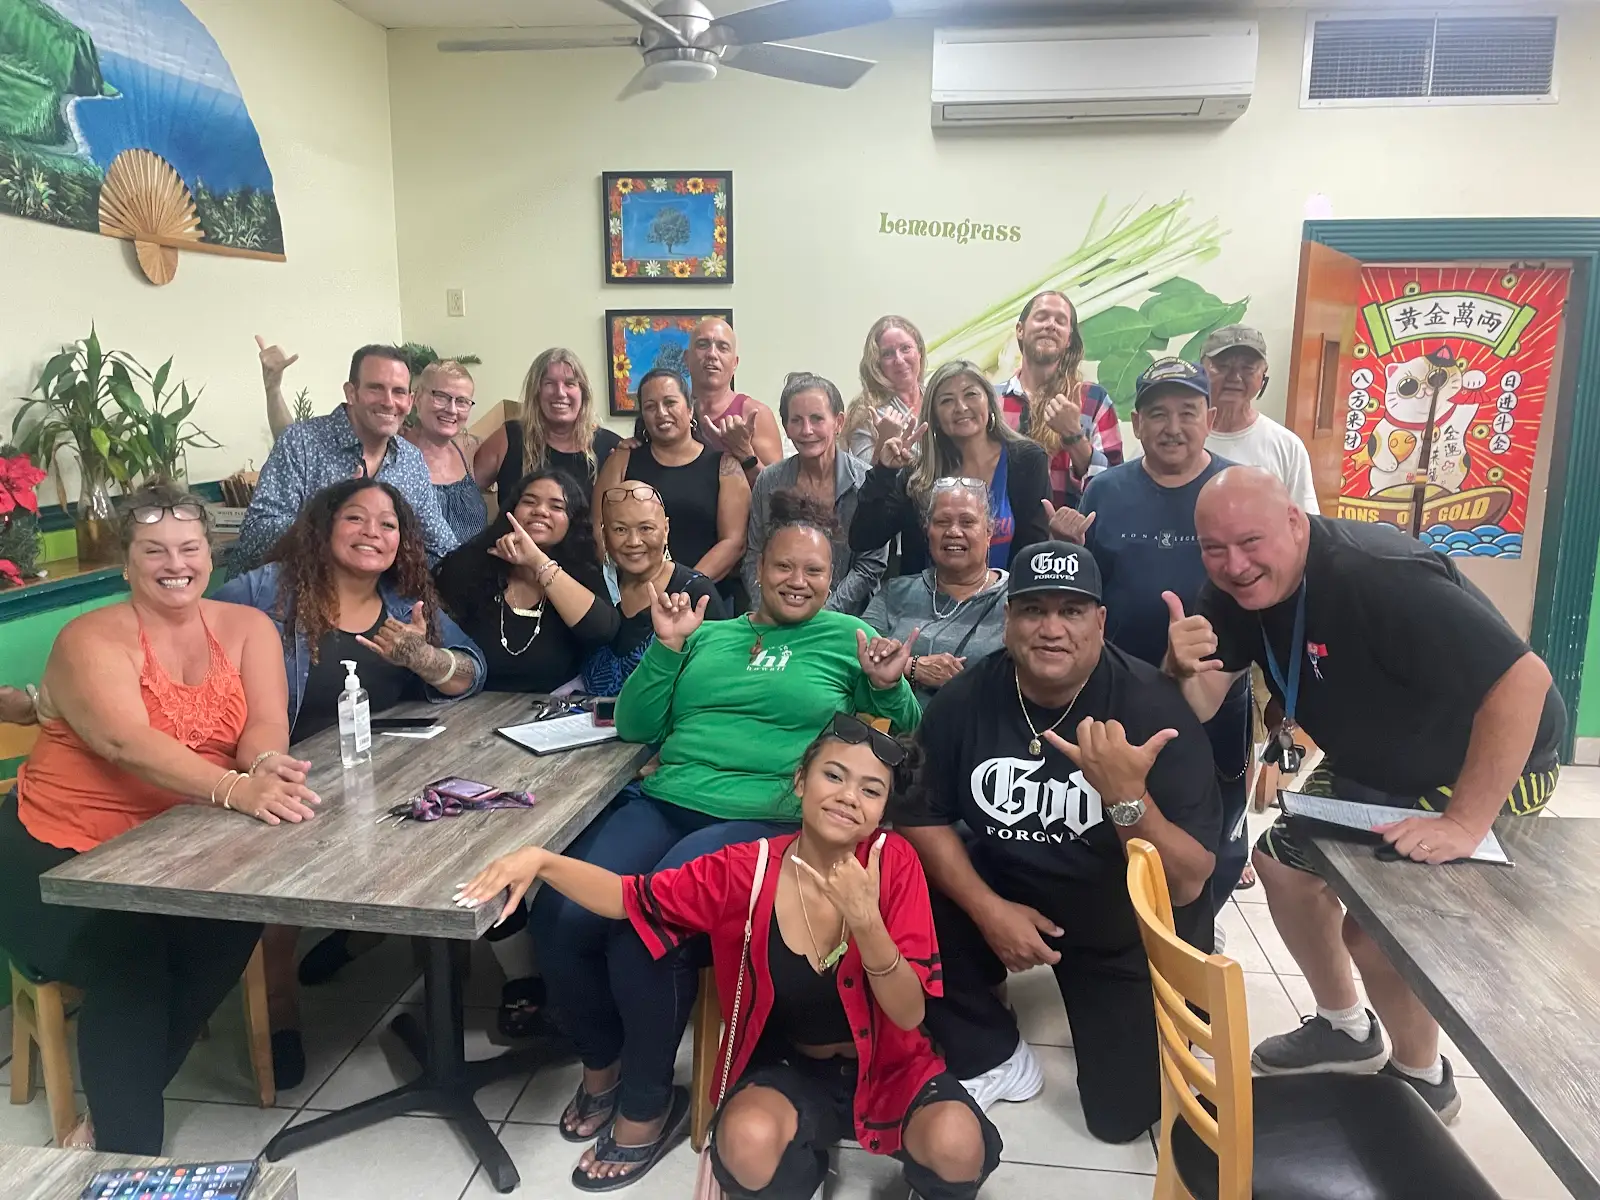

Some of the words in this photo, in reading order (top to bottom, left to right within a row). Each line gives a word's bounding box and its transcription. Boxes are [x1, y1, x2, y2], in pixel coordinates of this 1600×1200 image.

[879, 212, 1021, 244] Lemongrass
[1438, 496, 1492, 522] GOLD
[1121, 533, 1159, 541] KONA
[1030, 551, 1079, 576] God
[970, 756, 1105, 837] God
